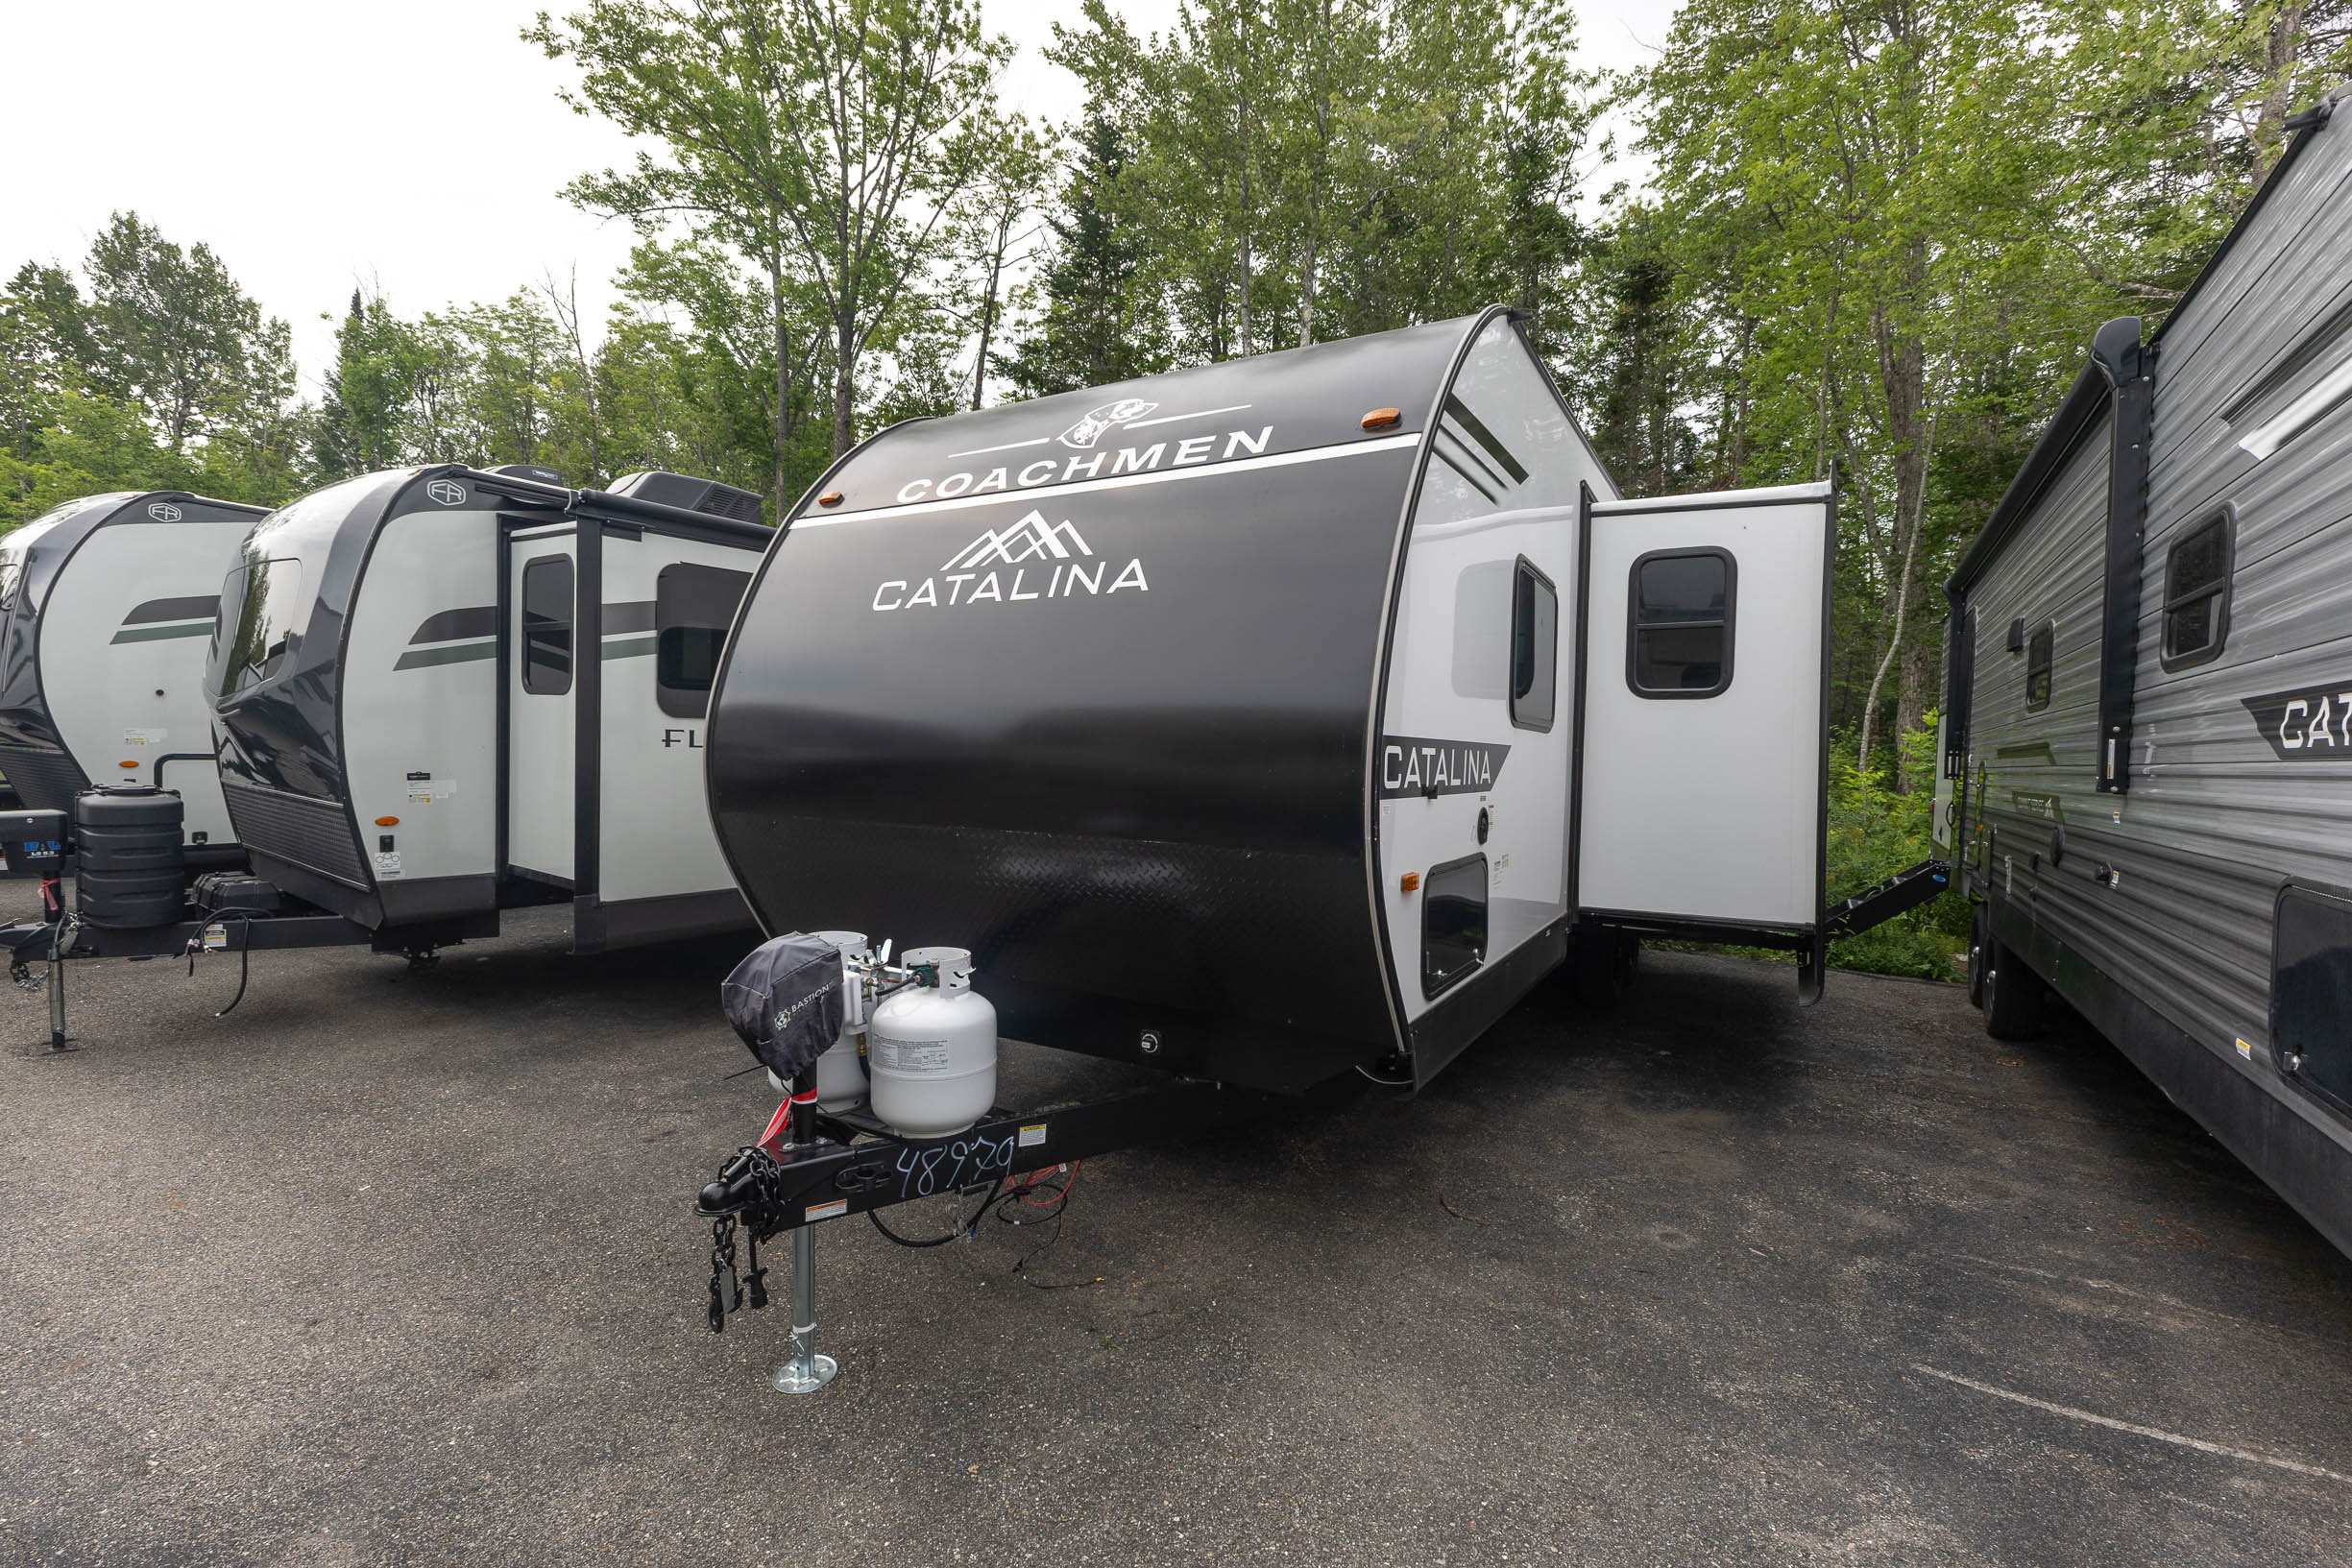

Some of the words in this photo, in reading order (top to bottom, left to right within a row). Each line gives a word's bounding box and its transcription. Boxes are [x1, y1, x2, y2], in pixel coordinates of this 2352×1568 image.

[896, 425, 1274, 504] COACHMEN
[871, 558, 1150, 612] CATALINA
[2279, 692, 2352, 749] CAT
[1384, 745, 1491, 789] CATALINA
[790, 983, 830, 1013] BASTION
